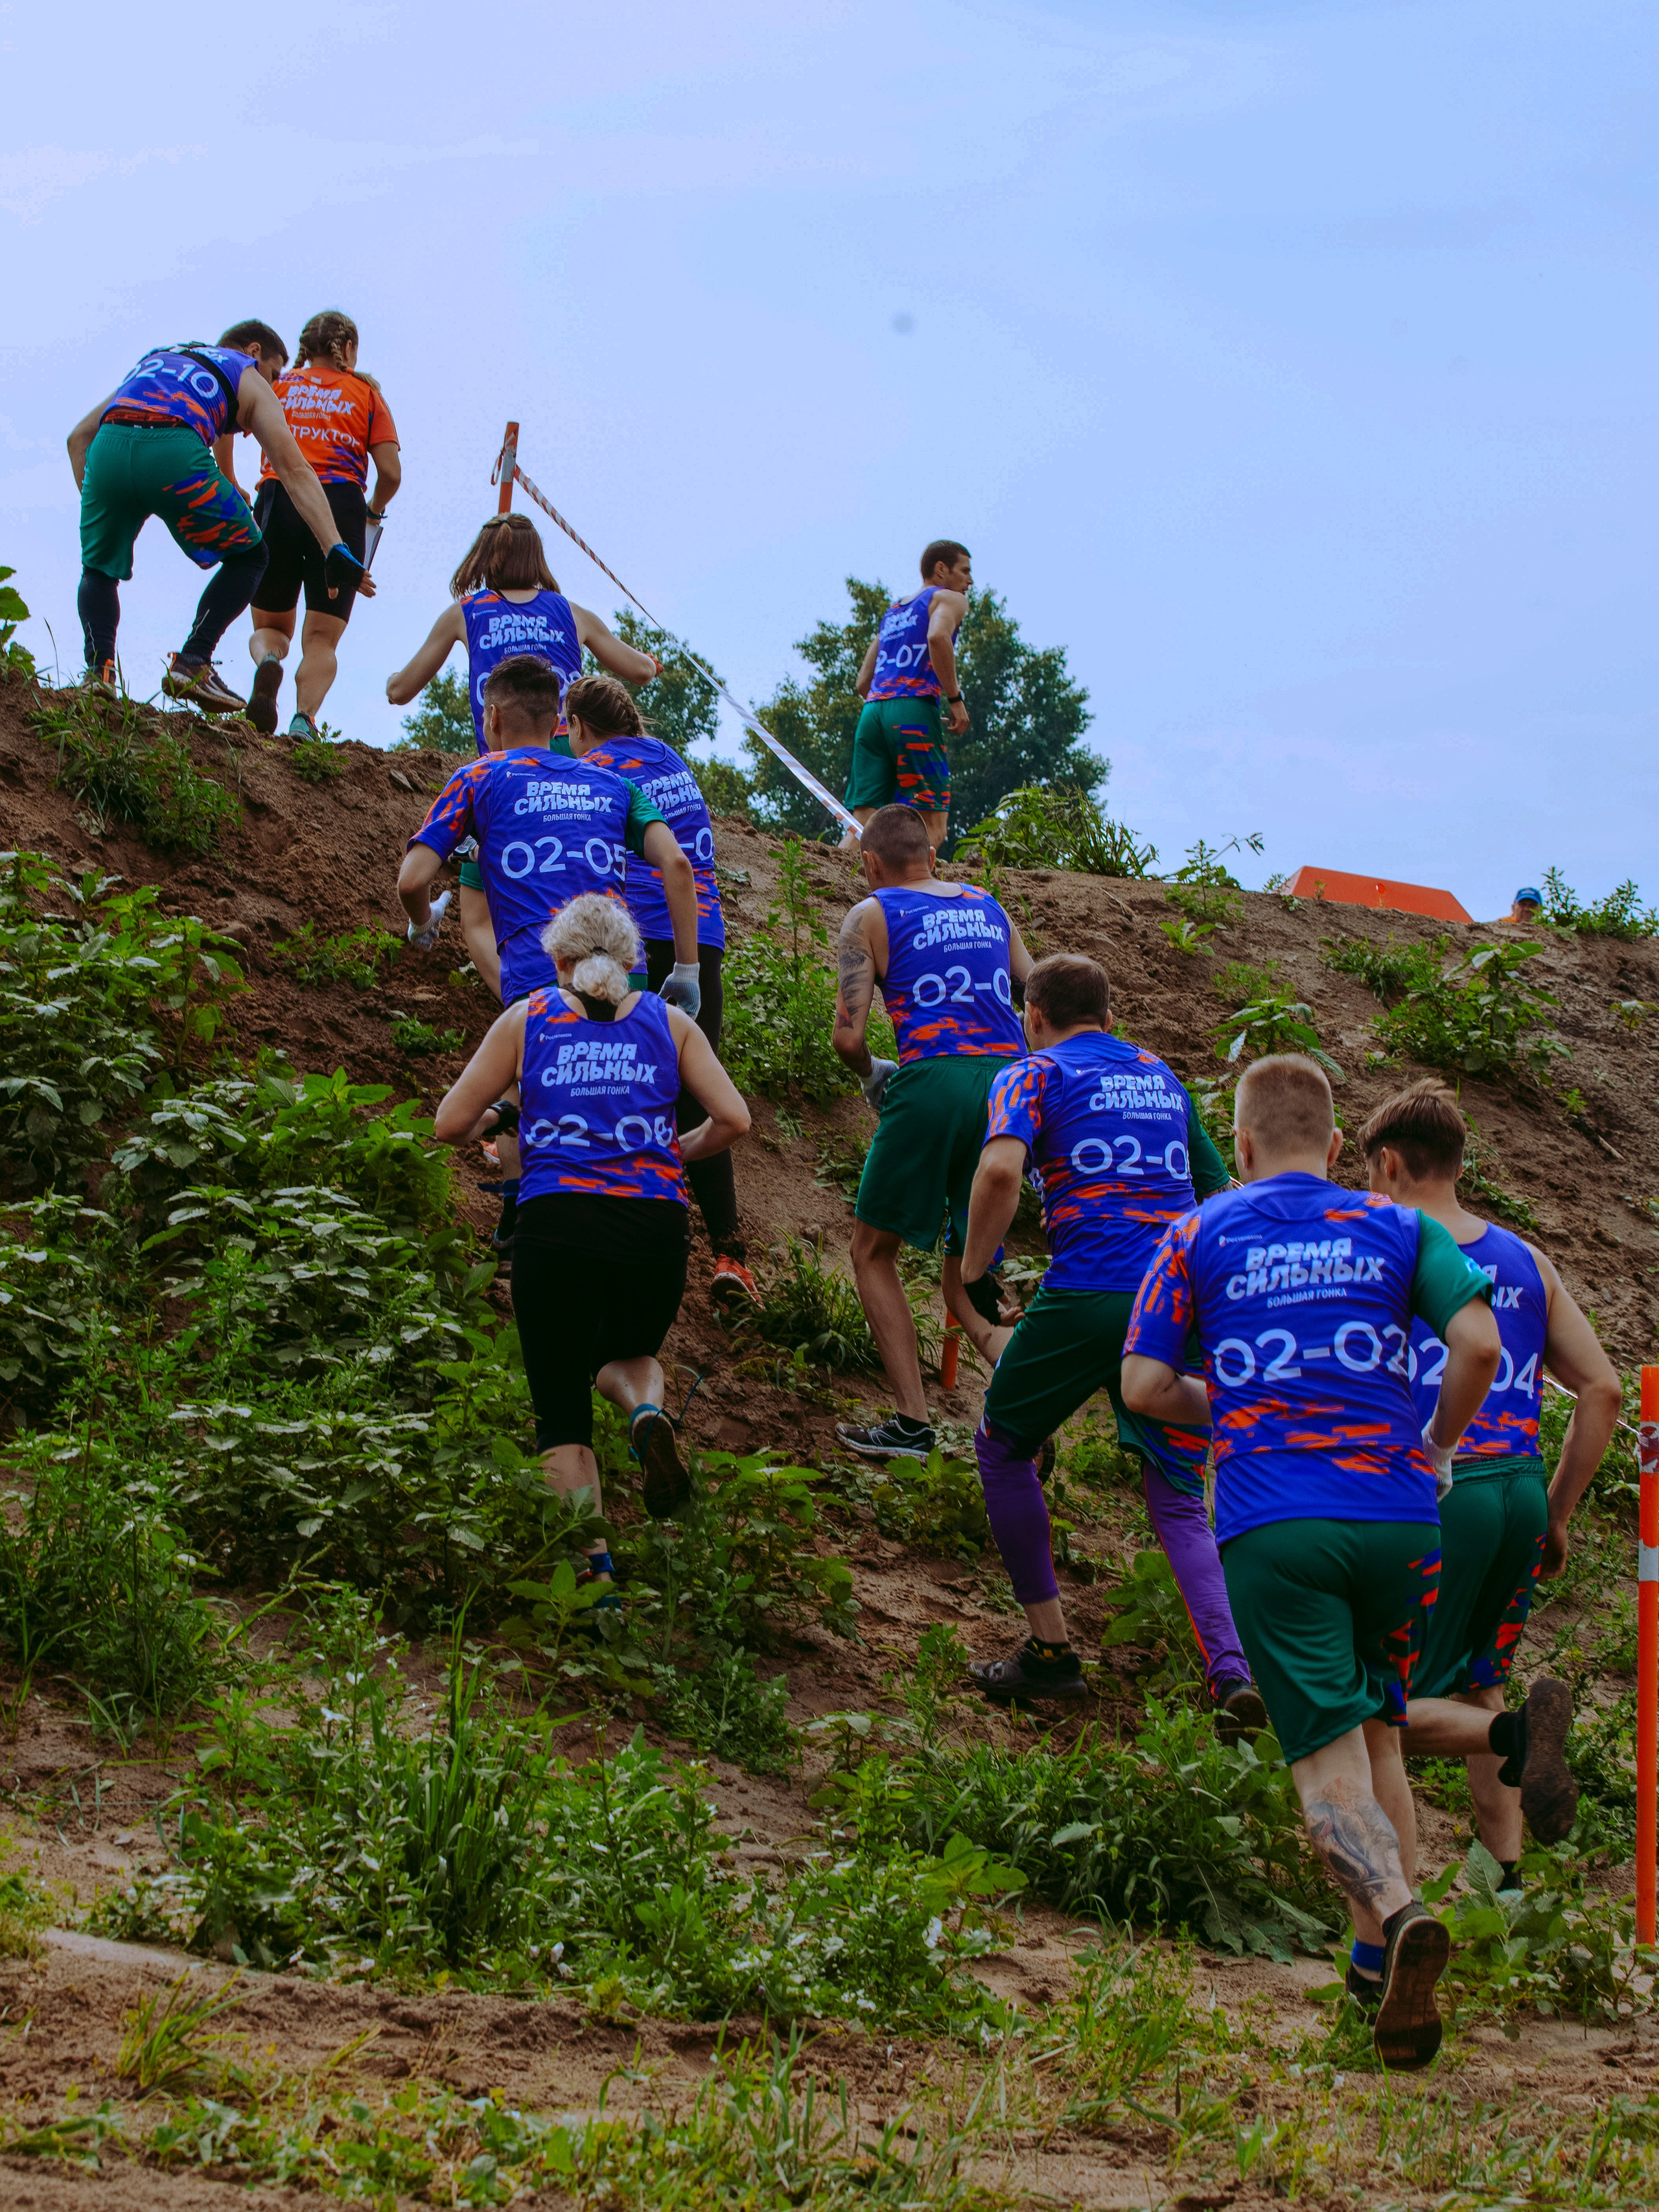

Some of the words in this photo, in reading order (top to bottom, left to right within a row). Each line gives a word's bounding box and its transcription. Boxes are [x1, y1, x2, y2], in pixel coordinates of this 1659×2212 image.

[287, 385, 342, 400] ВРЕМЯ
[280, 397, 356, 415] СИЛЬНЫХ
[290, 424, 360, 447] ТРУКТО
[489, 614, 547, 633] ВРЕМЯ
[480, 626, 565, 649] СИЛЬНЫХ
[504, 645, 530, 655] БОЛЬШАЯ
[875, 644, 927, 675] 2-07
[527, 782, 590, 797] ВРЕМЯ
[642, 771, 693, 799] ВРЕМЯ
[515, 795, 612, 815] СИЛЬНЫХ
[663, 808, 686, 820] ОЛЬШАЯ
[543, 813, 573, 822] БОЛЬШАЯ
[574, 813, 591, 821] ГОНКА
[501, 836, 627, 881] 02-05
[922, 909, 986, 931] ВРЕМЯ
[912, 922, 1004, 950] СИЛЬНЫХ
[944, 942, 973, 953] БОЛЬШАЯ
[974, 941, 992, 949] ГОНКА
[912, 966, 1011, 1007] 02-0
[557, 1042, 637, 1065] ВРЕМЯ
[541, 1060, 658, 1087] СИЛЬНЫХ
[1100, 1075, 1166, 1092] ВРЕМЯ
[570, 1086, 606, 1097] БОЛЬШАЯ
[607, 1085, 629, 1095] ГОНКА
[1089, 1089, 1183, 1112] СИЛЬНЫХ
[1122, 1112, 1152, 1120] БОЛЬШАЯ
[1153, 1112, 1172, 1121] ГОНКА
[1071, 1135, 1191, 1180] 02-0
[1246, 1237, 1351, 1271] ВРЕМЯ
[1226, 1256, 1386, 1301] СИЛЬНЫХ
[1267, 1290, 1314, 1309] БОЛЬШАЯ
[1316, 1288, 1347, 1300] ГОНКА
[1213, 1321, 1408, 1386] 02-02
